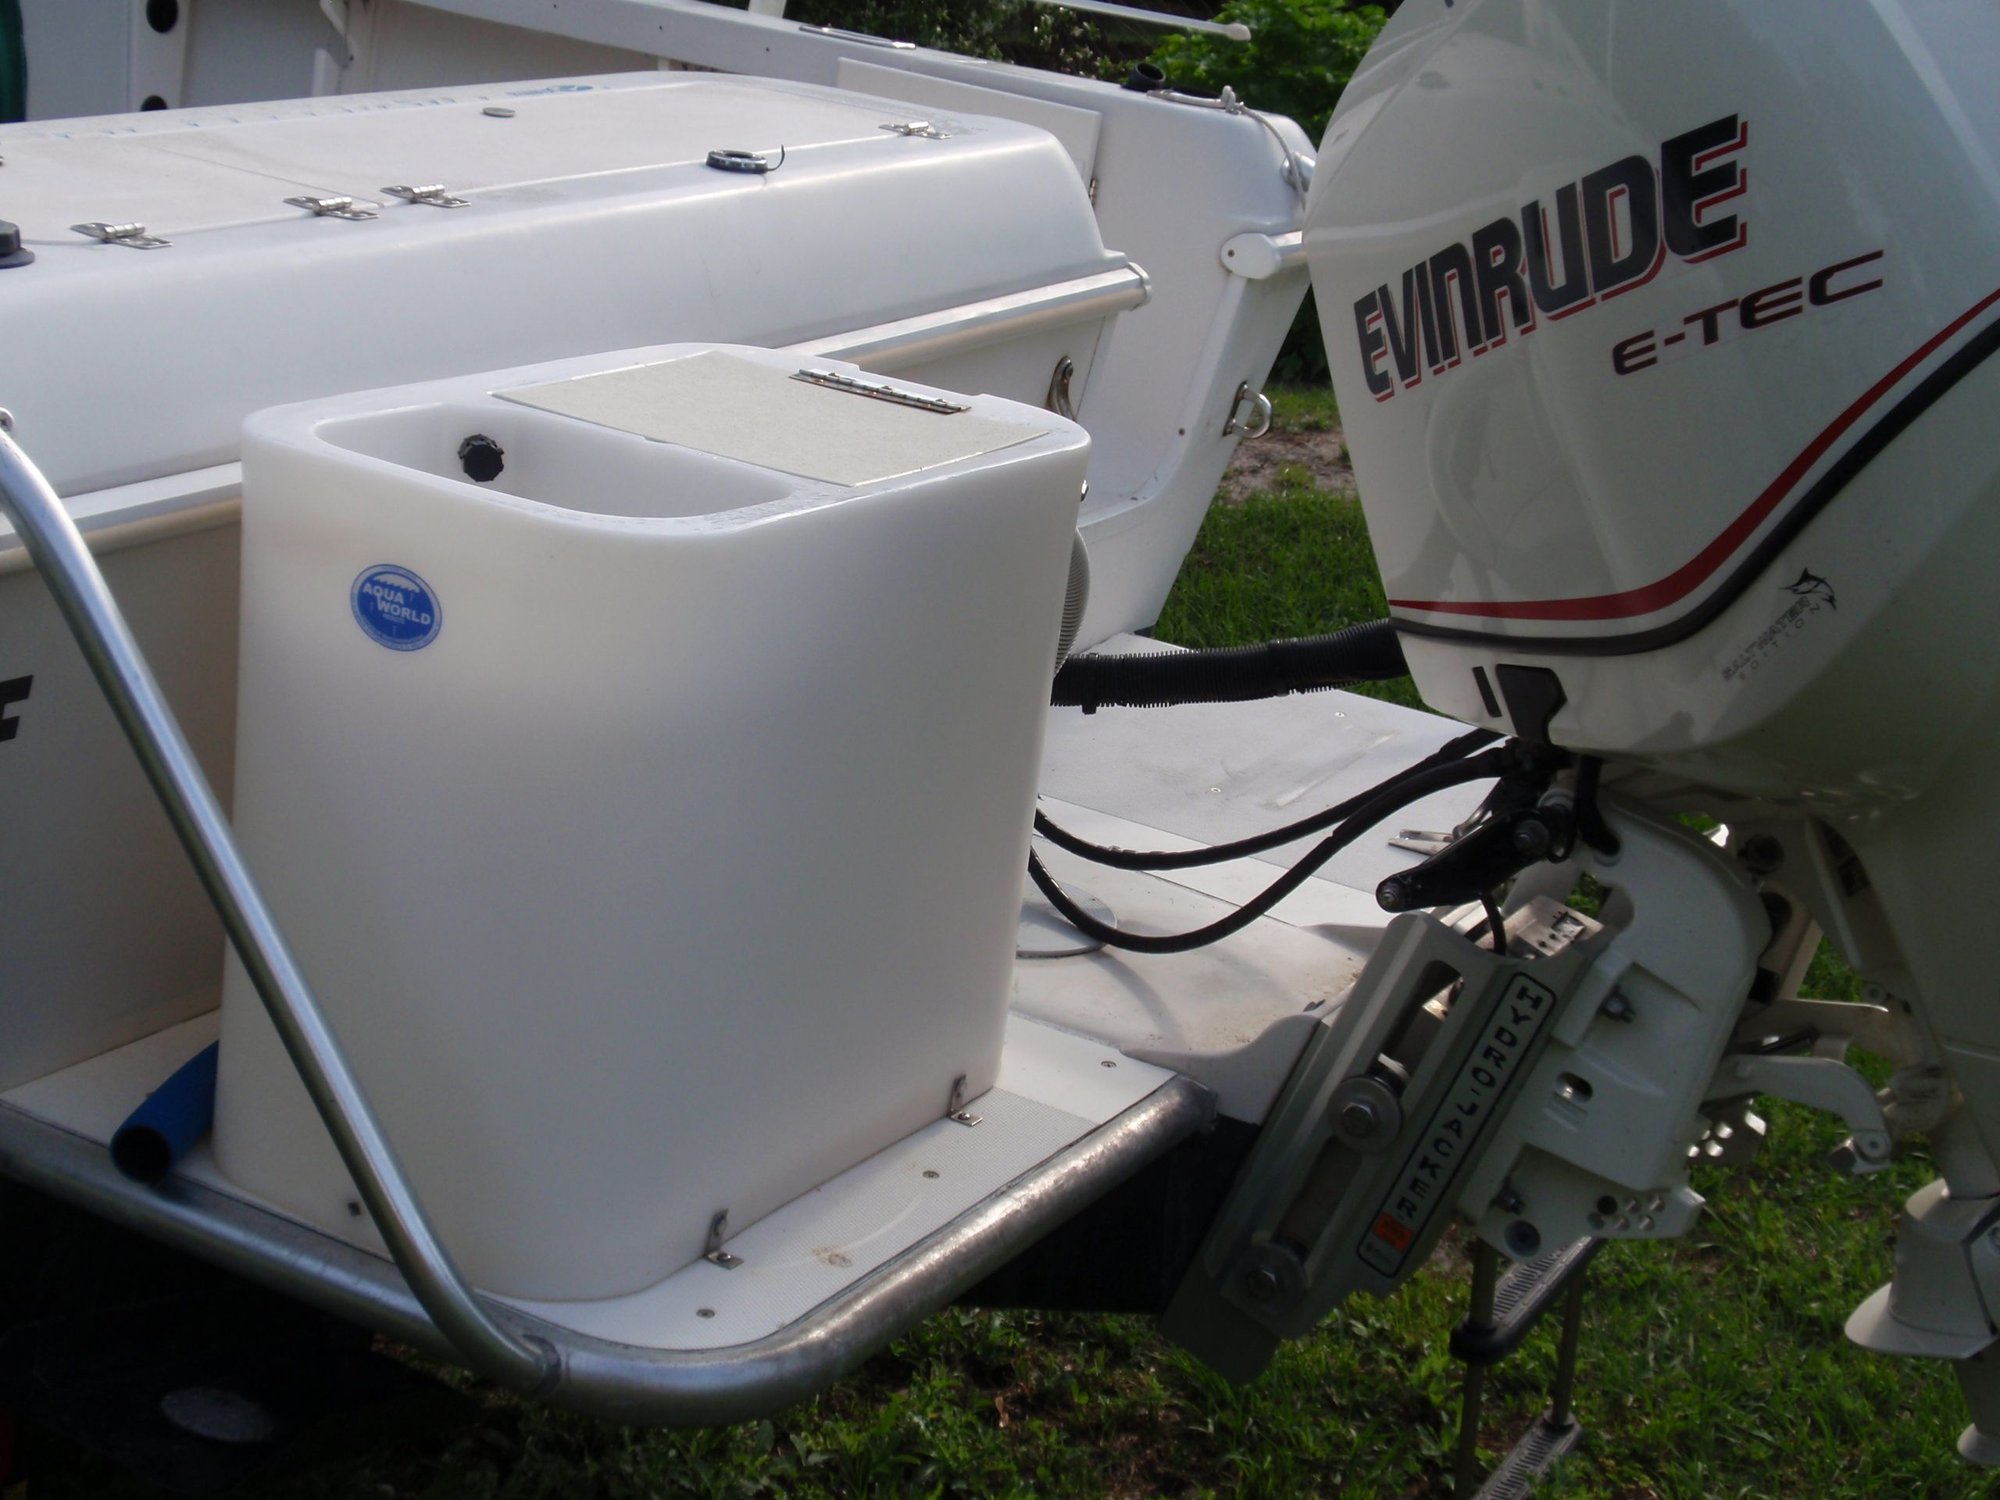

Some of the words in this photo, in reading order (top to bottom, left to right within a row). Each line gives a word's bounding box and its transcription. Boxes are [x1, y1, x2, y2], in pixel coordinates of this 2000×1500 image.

[1354, 113, 1747, 402] EVINRUDE
[1612, 249, 1883, 375] E-TEC
[362, 582, 405, 605] AQUA
[377, 601, 431, 625] WORLD
[1397, 985, 1543, 1220] HYDRO-JACKER
